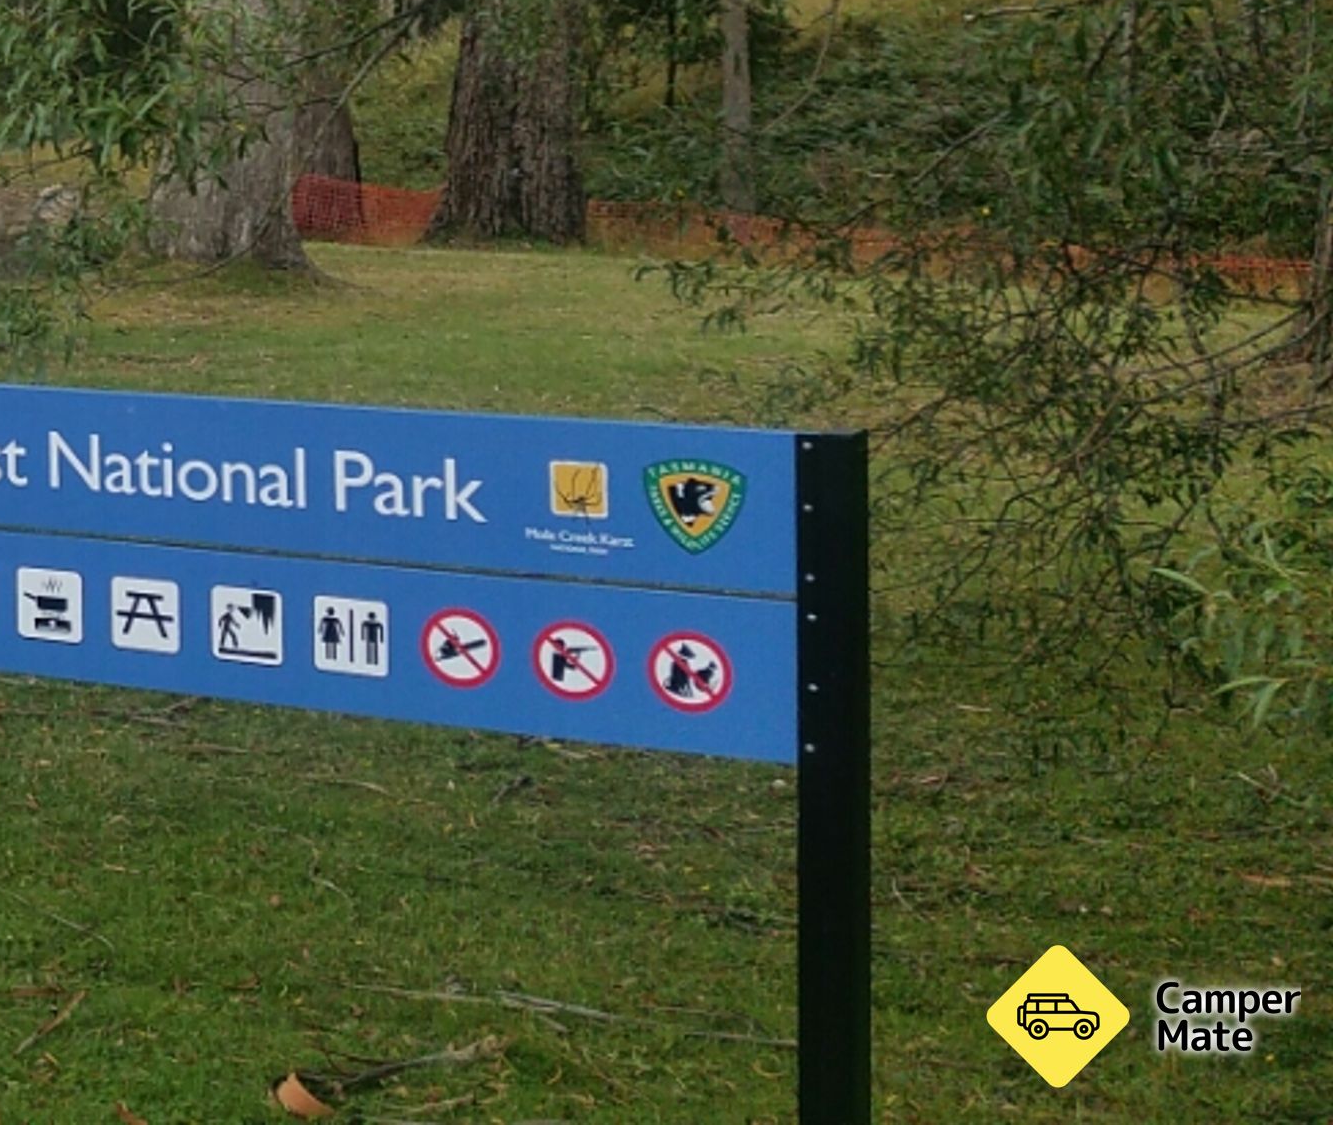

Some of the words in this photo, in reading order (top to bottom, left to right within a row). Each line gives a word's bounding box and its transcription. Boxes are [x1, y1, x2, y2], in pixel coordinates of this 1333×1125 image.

[47, 431, 307, 509] National
[334, 450, 488, 523] Park
[648, 462, 740, 484] TASMANIA
